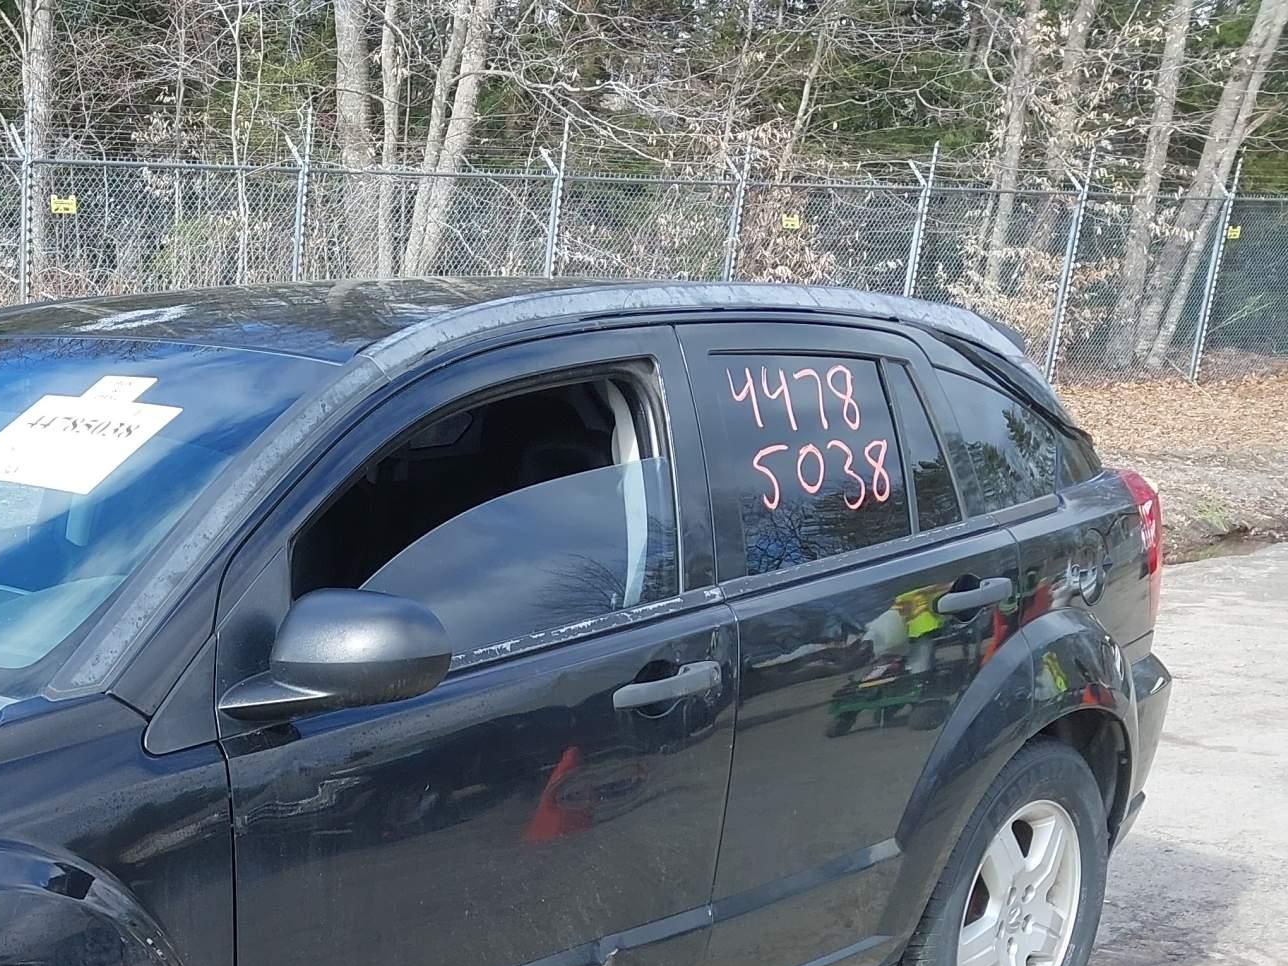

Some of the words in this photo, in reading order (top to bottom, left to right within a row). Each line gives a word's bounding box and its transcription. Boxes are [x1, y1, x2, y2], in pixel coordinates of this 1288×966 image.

[27, 415, 141, 439] 44785038
[725, 364, 861, 431] 4478
[751, 438, 891, 511] 5038
